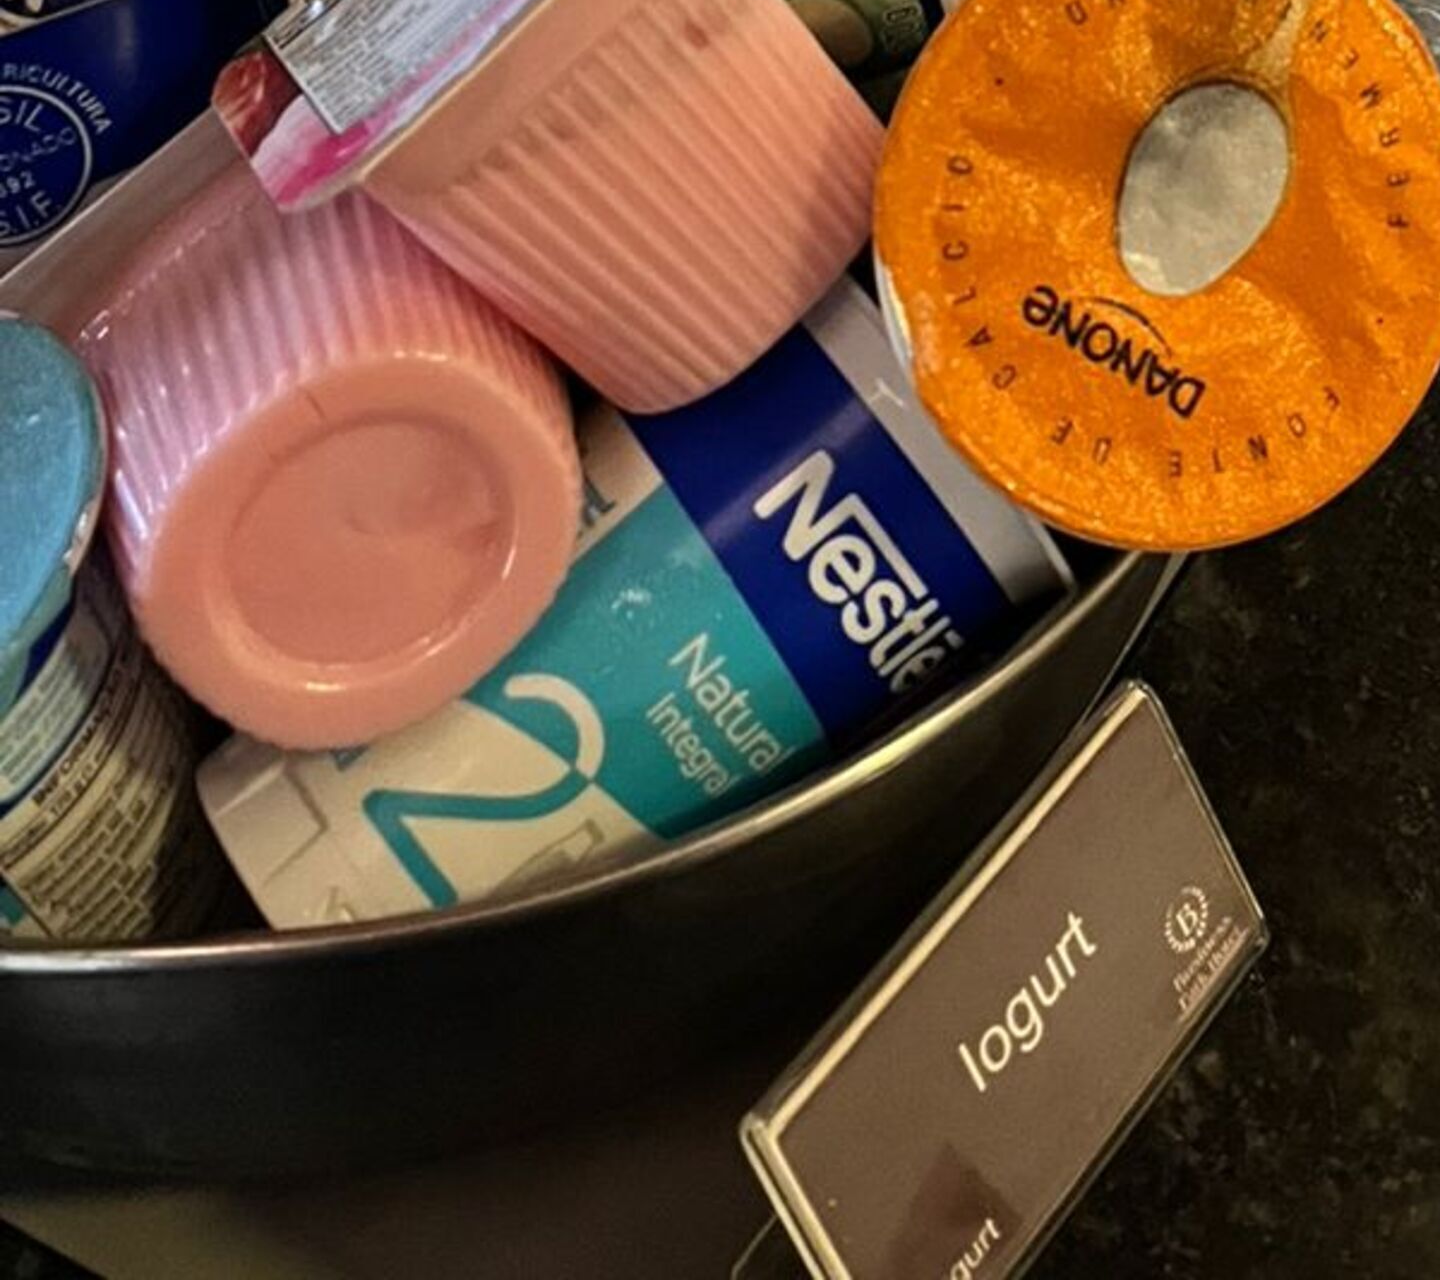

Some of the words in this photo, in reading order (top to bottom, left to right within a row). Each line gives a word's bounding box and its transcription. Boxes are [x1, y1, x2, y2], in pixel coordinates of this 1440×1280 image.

[2, 63, 112, 134] RICULTURA
[1022, 284, 1206, 419] DANONe
[645, 695, 741, 799] Integral
[667, 630, 797, 777] Natural
[957, 912, 1098, 1092] Iogurt
[950, 1218, 1001, 1280] gurt
